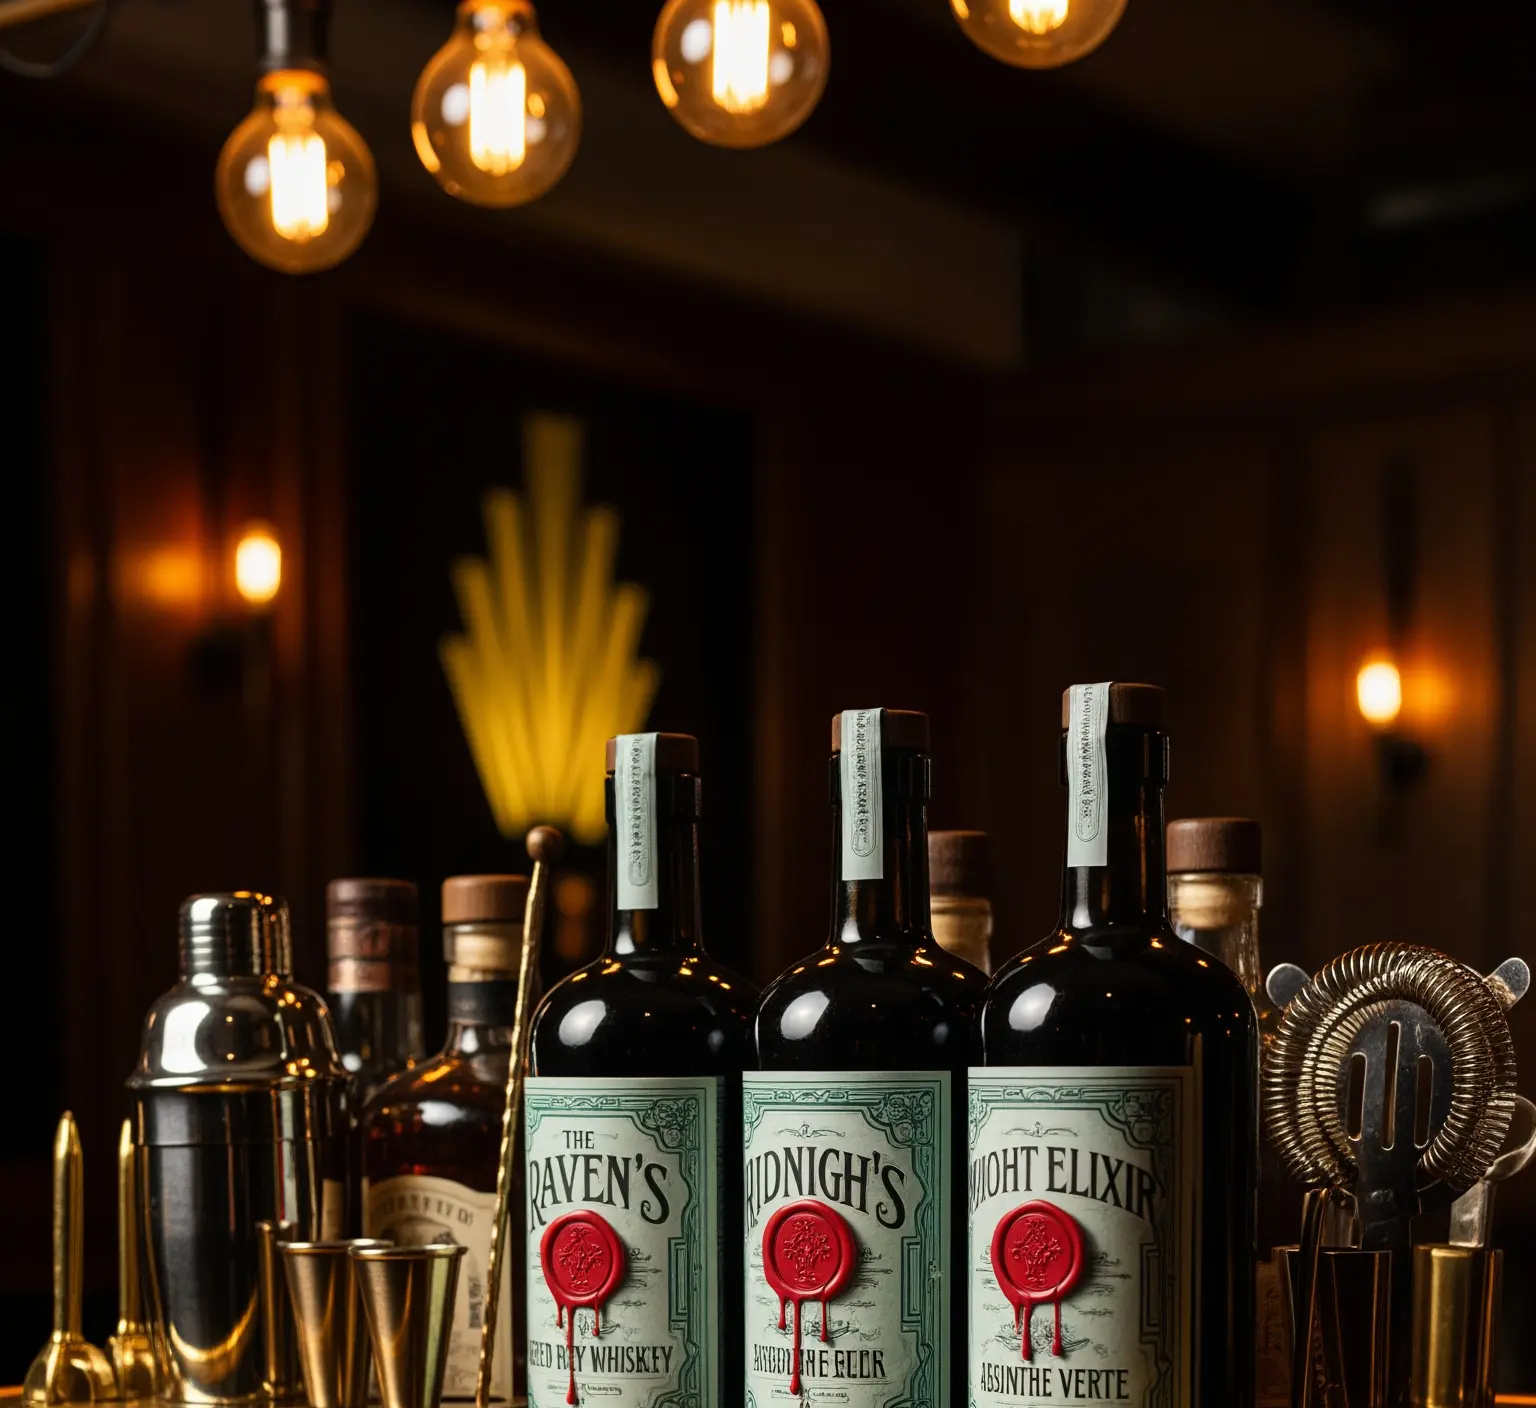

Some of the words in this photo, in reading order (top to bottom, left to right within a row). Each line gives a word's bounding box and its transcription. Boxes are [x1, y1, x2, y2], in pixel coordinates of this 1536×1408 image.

[562, 1130, 595, 1149] THE
[529, 1153, 670, 1233] RAVEN'S
[1046, 1146, 1157, 1220] ELIXIR
[1058, 1368, 1130, 1399] VERTE
